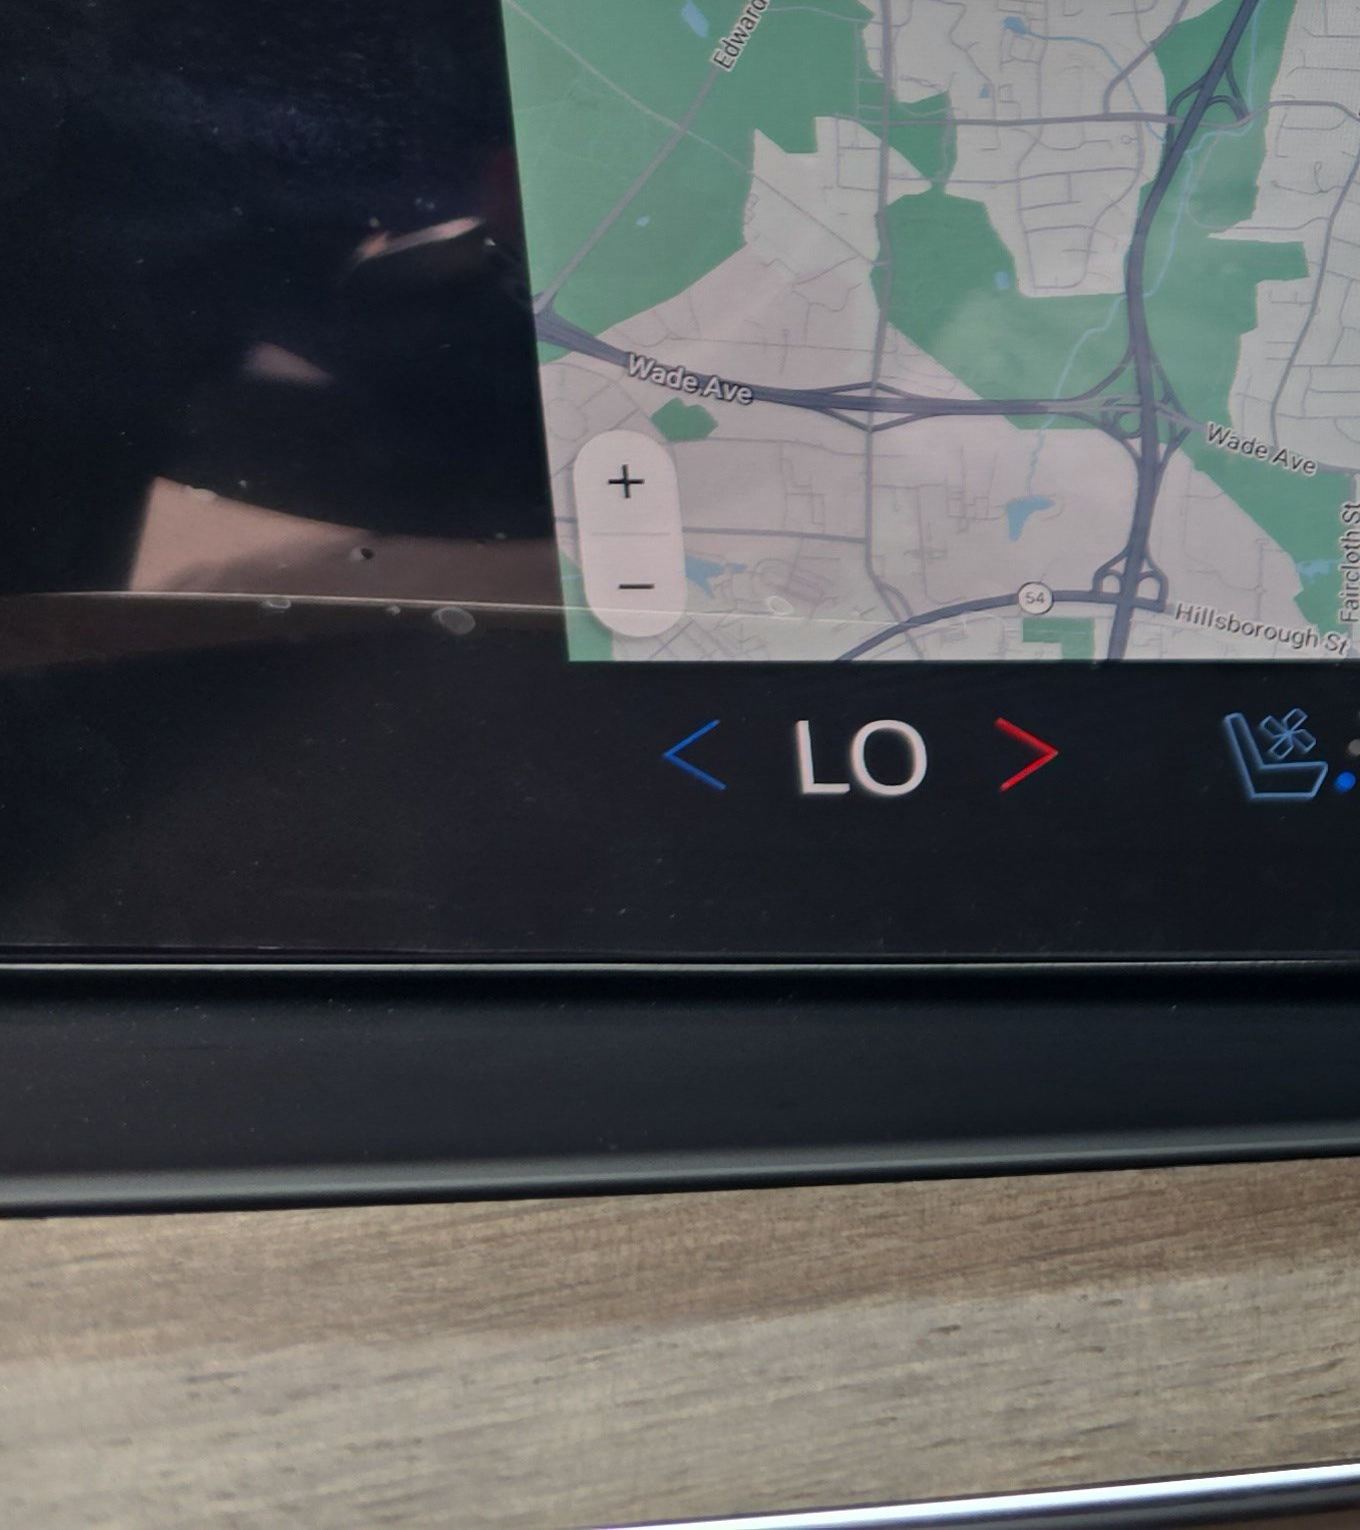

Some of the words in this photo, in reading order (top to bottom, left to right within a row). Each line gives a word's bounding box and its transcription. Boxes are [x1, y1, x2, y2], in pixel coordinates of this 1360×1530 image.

[626, 352, 696, 394] Wade
[699, 373, 754, 405] Ave
[1206, 423, 1268, 461] Wade
[1271, 446, 1317, 476] Ave
[1342, 501, 1360, 523] St
[1026, 590, 1045, 606] 54
[1341, 529, 1360, 623] Faircloth
[1176, 603, 1318, 649] Hillsborough
[1324, 632, 1349, 654] St
[796, 719, 928, 796] LO
